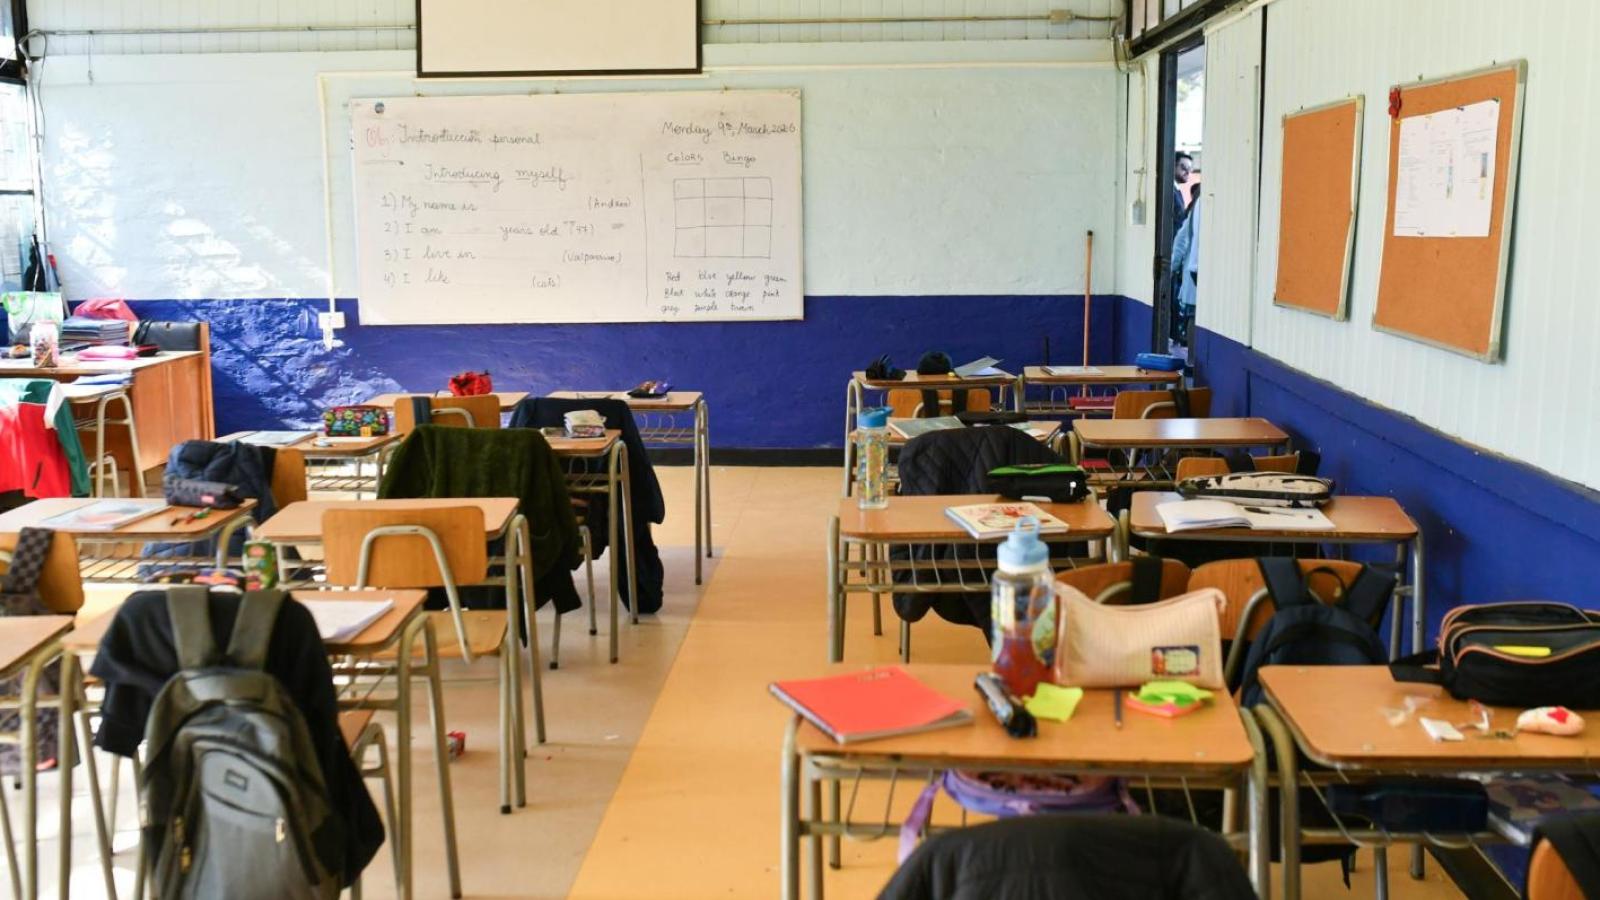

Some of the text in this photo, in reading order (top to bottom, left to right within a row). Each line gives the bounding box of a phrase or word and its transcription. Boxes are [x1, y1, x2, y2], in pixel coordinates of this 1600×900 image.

[662, 121, 712, 144] Monday
[722, 151, 756, 168] Bingo
[424, 163, 570, 192] Introducing myself
[401, 194, 419, 218] My
[423, 200, 456, 211] name
[462, 200, 479, 212] is
[404, 222, 414, 234] I
[420, 226, 444, 235] am
[402, 247, 412, 260] I
[423, 244, 452, 260] live
[456, 249, 477, 260] in
[402, 272, 412, 284] I
[424, 266, 450, 284] like
[726, 271, 756, 286] yellow
